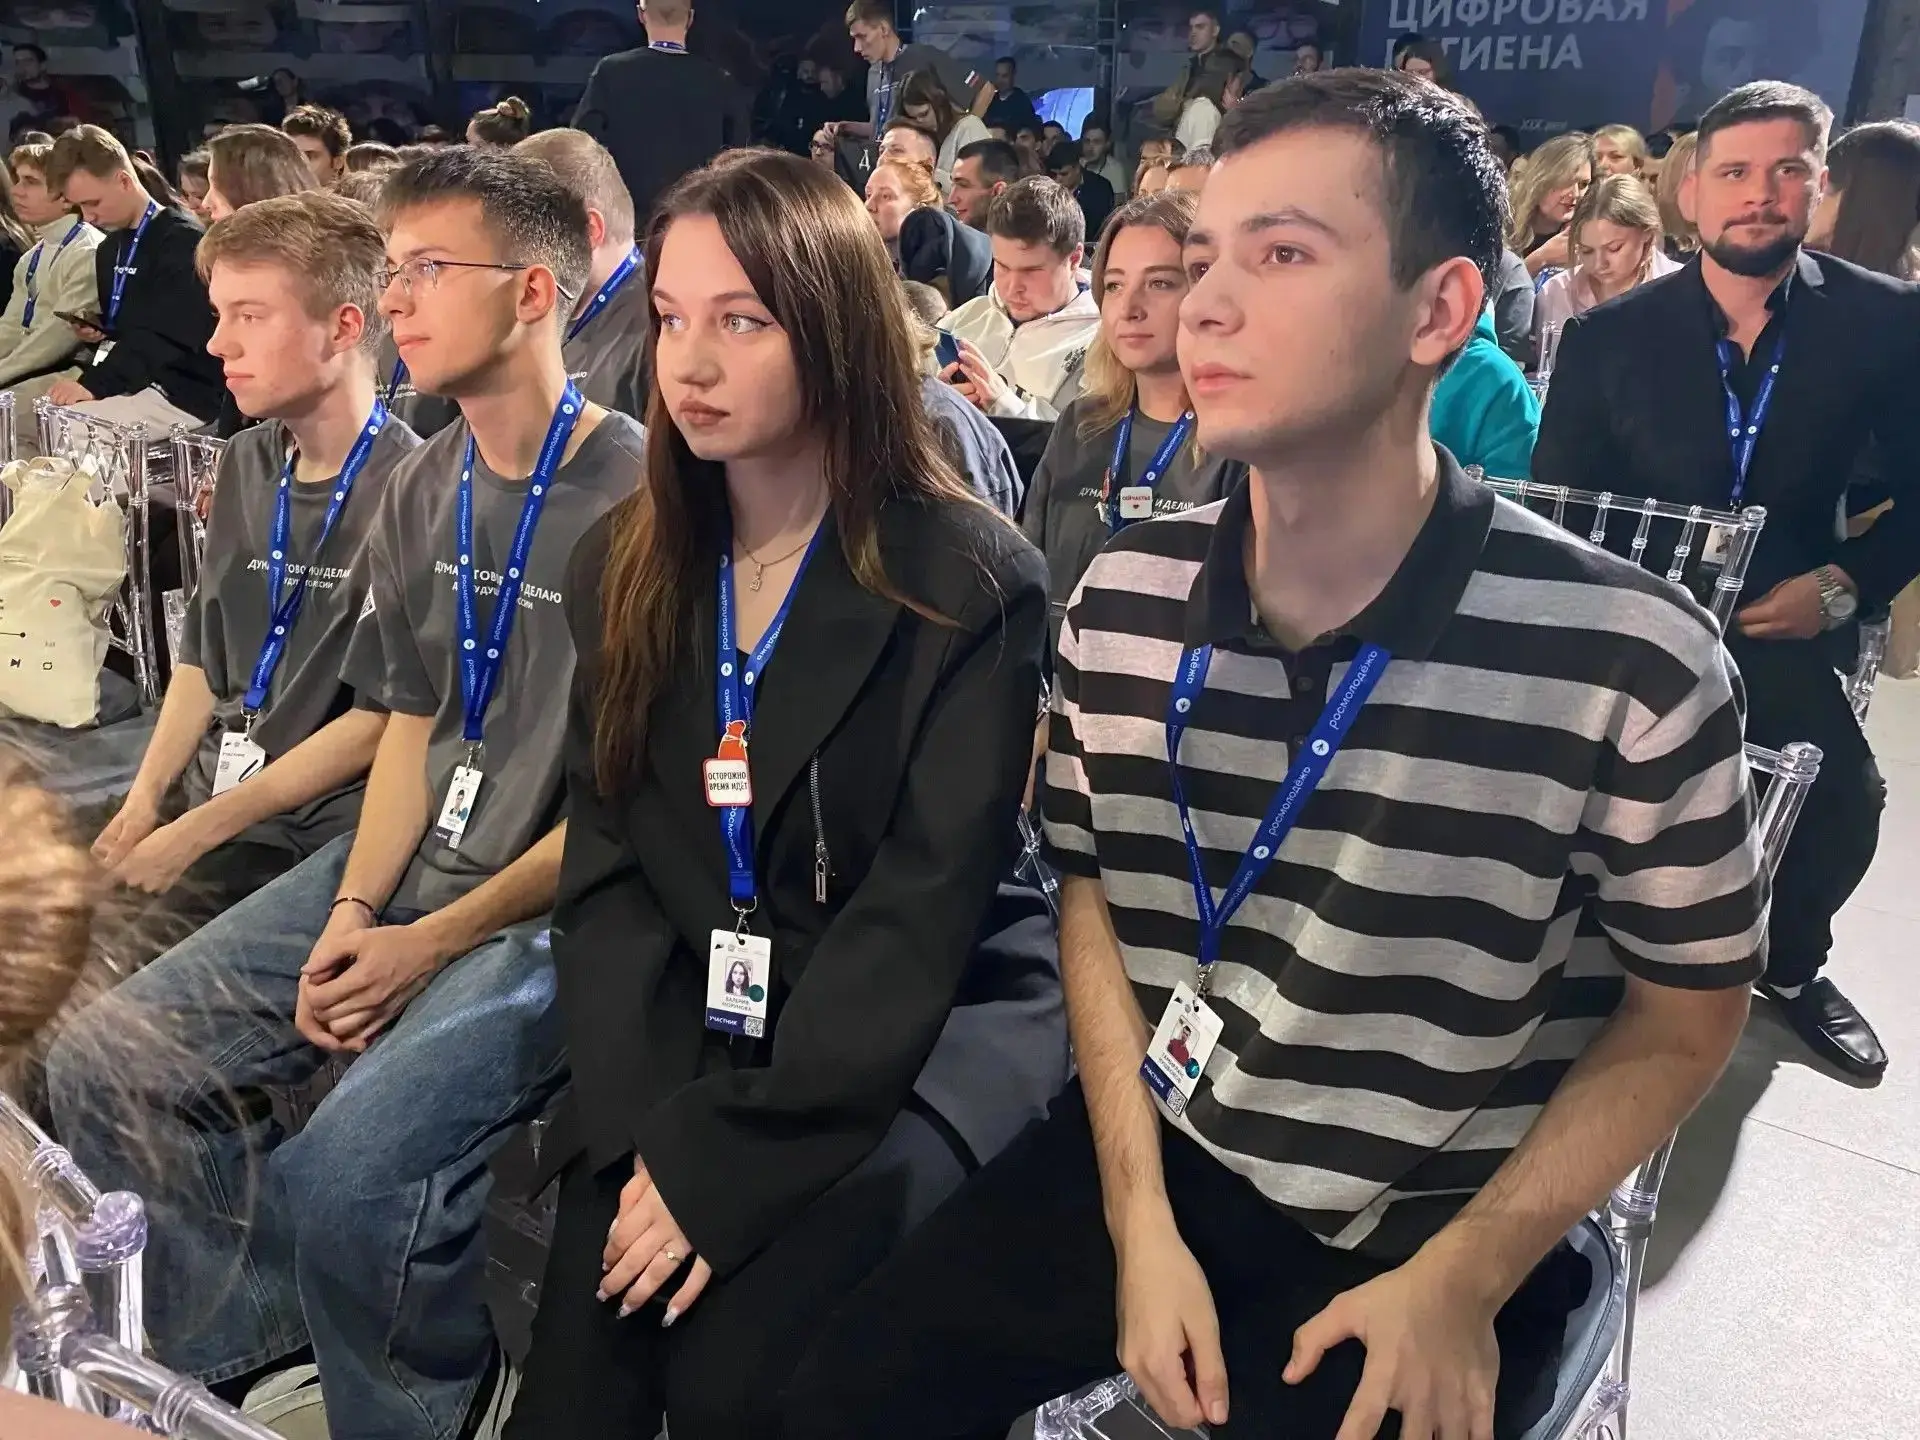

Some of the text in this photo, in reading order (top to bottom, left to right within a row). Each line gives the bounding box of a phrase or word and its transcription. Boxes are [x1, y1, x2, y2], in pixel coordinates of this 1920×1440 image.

[1388, 0, 1648, 33] ЦИФРОВАЯ
[1078, 487, 1102, 499] ДУМА
[434, 560, 459, 576] ДУМА
[523, 583, 562, 604] ДЕЛАЮ
[722, 579, 730, 651] росмолодёжь
[1328, 649, 1378, 730] росмолодёжь
[708, 771, 747, 781] ОСТОРОЖНО
[709, 782, 730, 791] ВРЕМЯ
[1267, 765, 1312, 837] росмолодёжь
[708, 1015, 738, 1026] УЧАСТНИК
